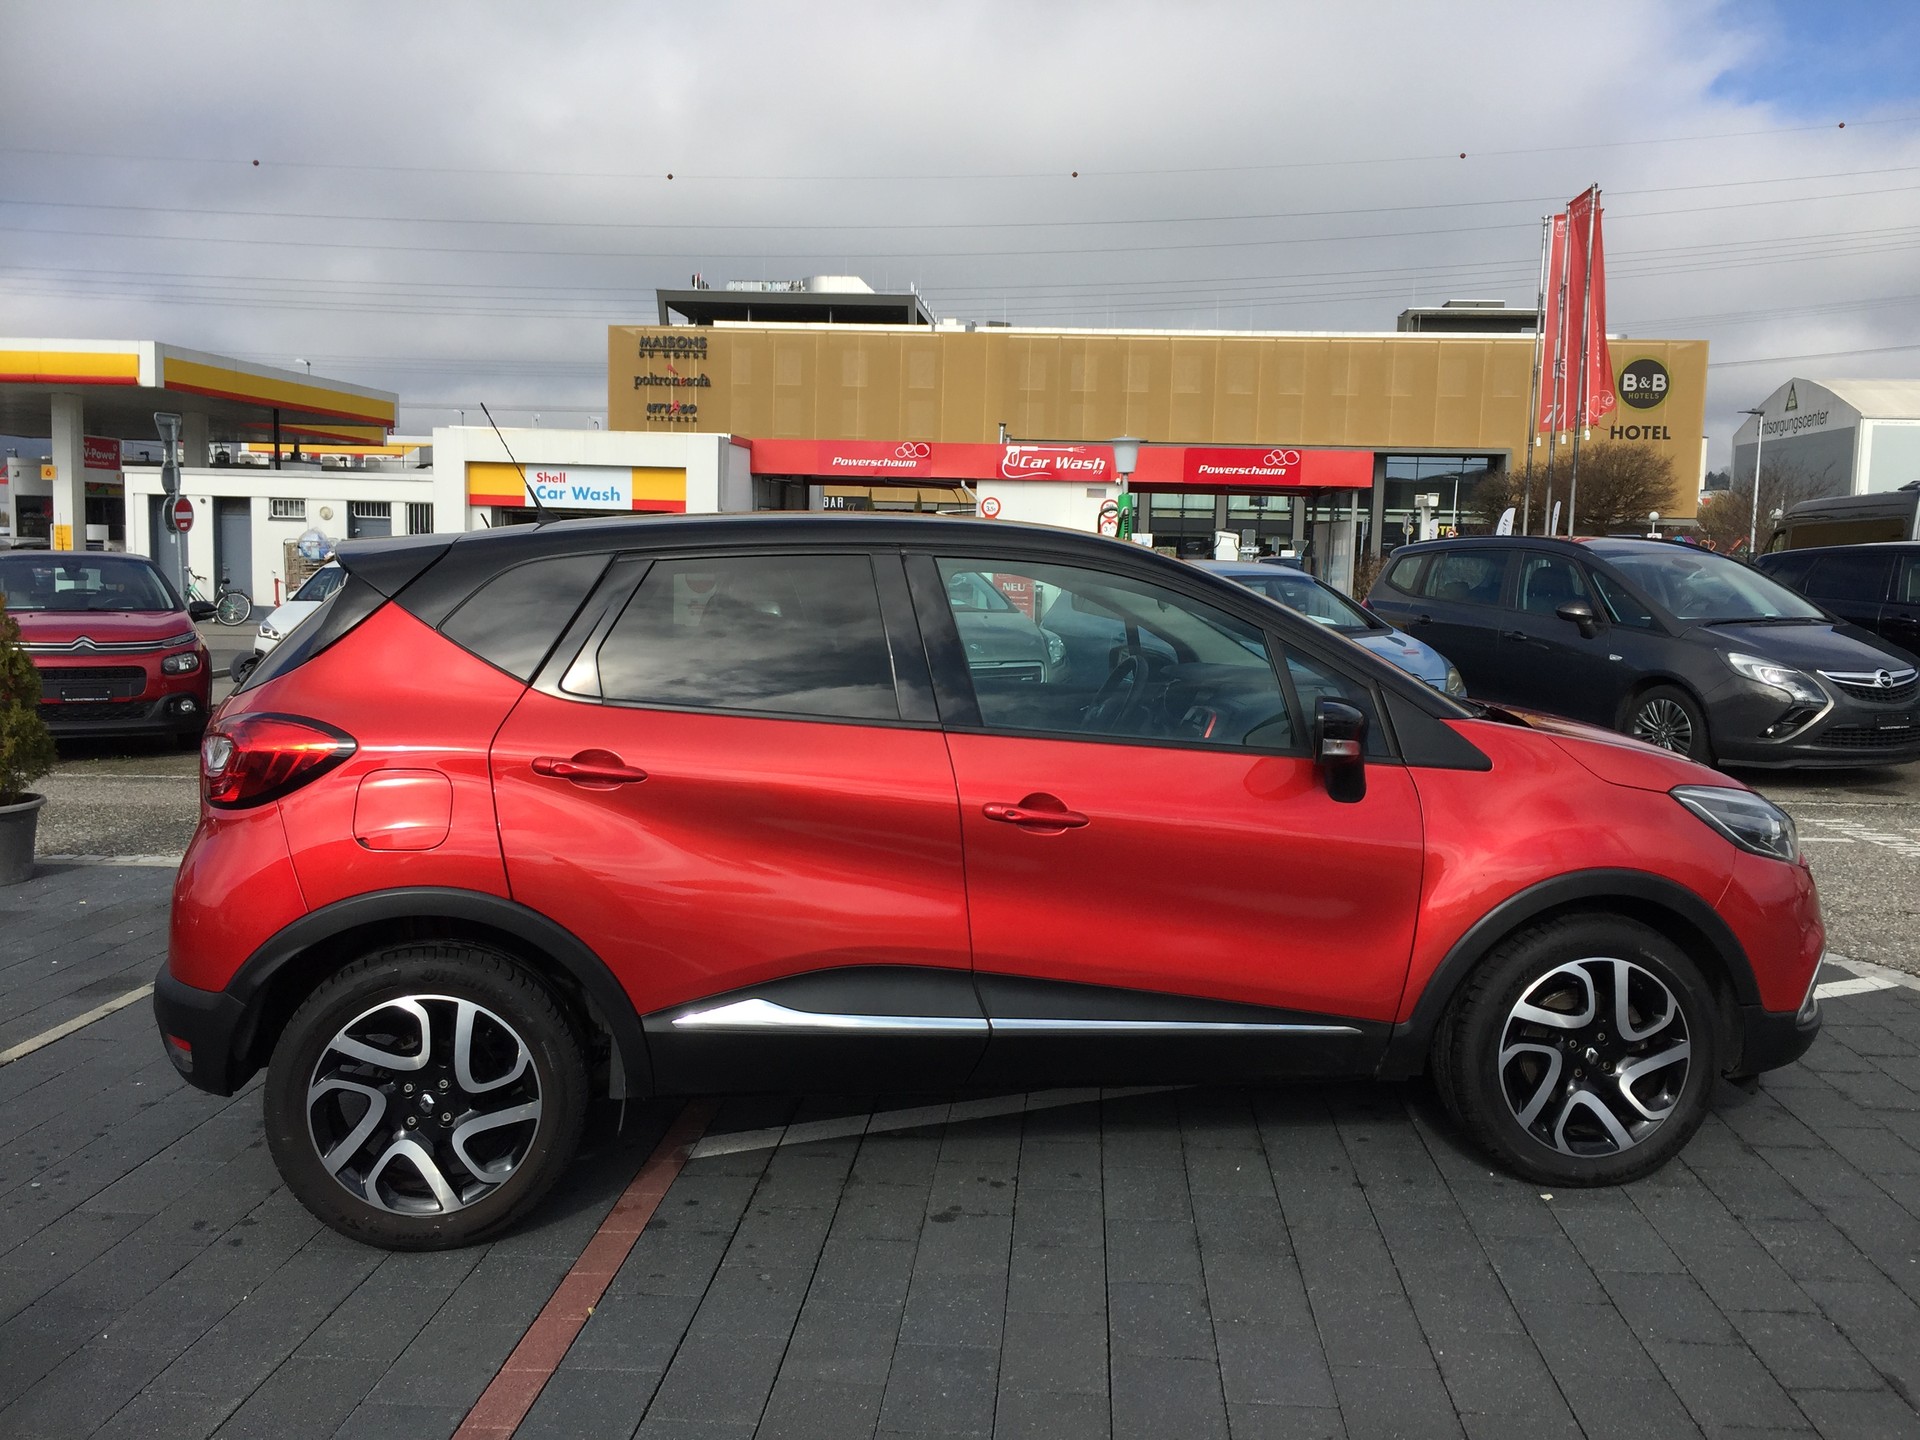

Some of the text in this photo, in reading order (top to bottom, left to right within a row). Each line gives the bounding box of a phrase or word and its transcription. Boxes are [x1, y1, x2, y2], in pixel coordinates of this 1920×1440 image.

[639, 336, 708, 349] MAISONS
[1622, 373, 1667, 392] B&B
[1628, 392, 1660, 400] HOTELS
[1610, 425, 1671, 440] HOTEL
[832, 456, 917, 468] Powerschaum
[1019, 456, 1106, 470] Car Wash
[45, 468, 52, 477] 6
[1198, 464, 1287, 476] Powerschaum
[536, 472, 566, 484] Shell
[536, 485, 621, 502] Car Wash
[823, 496, 844, 508] BAR
[1002, 582, 1026, 592] NEU
